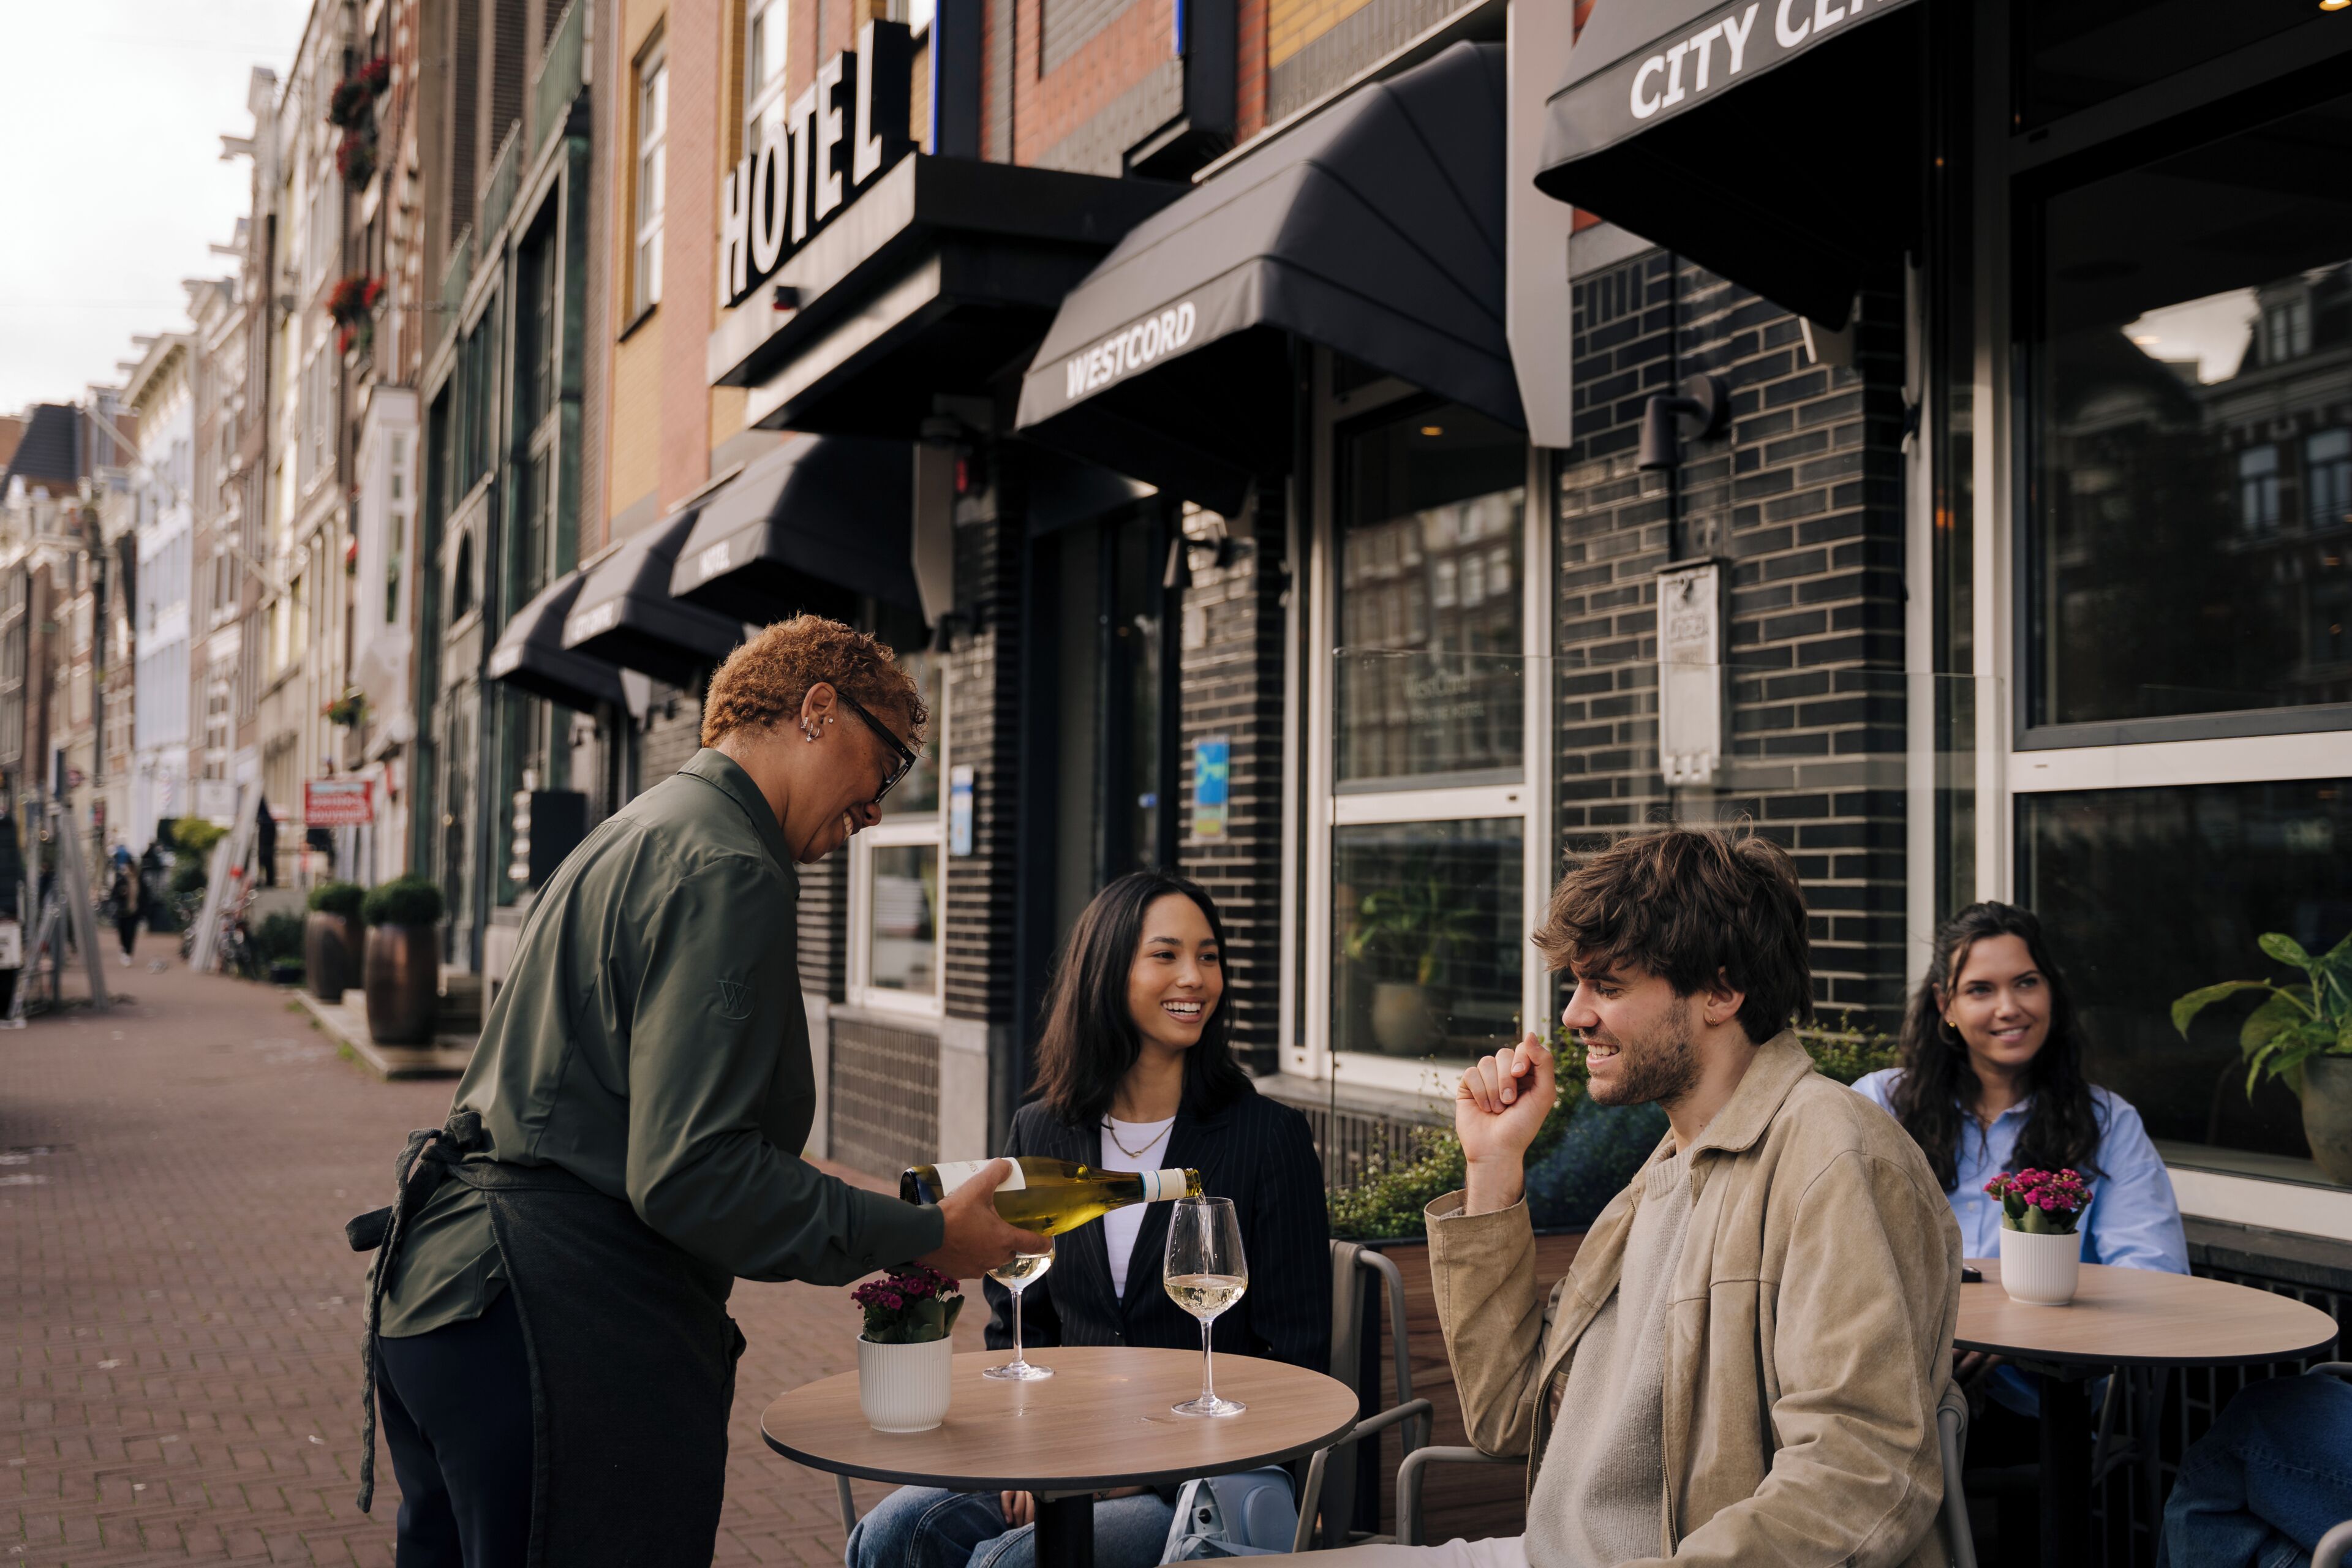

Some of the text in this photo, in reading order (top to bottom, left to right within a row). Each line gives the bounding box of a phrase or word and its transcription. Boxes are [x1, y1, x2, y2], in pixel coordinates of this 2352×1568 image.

[1630, 2, 1762, 119] CITY
[719, 19, 883, 309] HOTEL
[1065, 301, 1197, 400] WESTCORD
